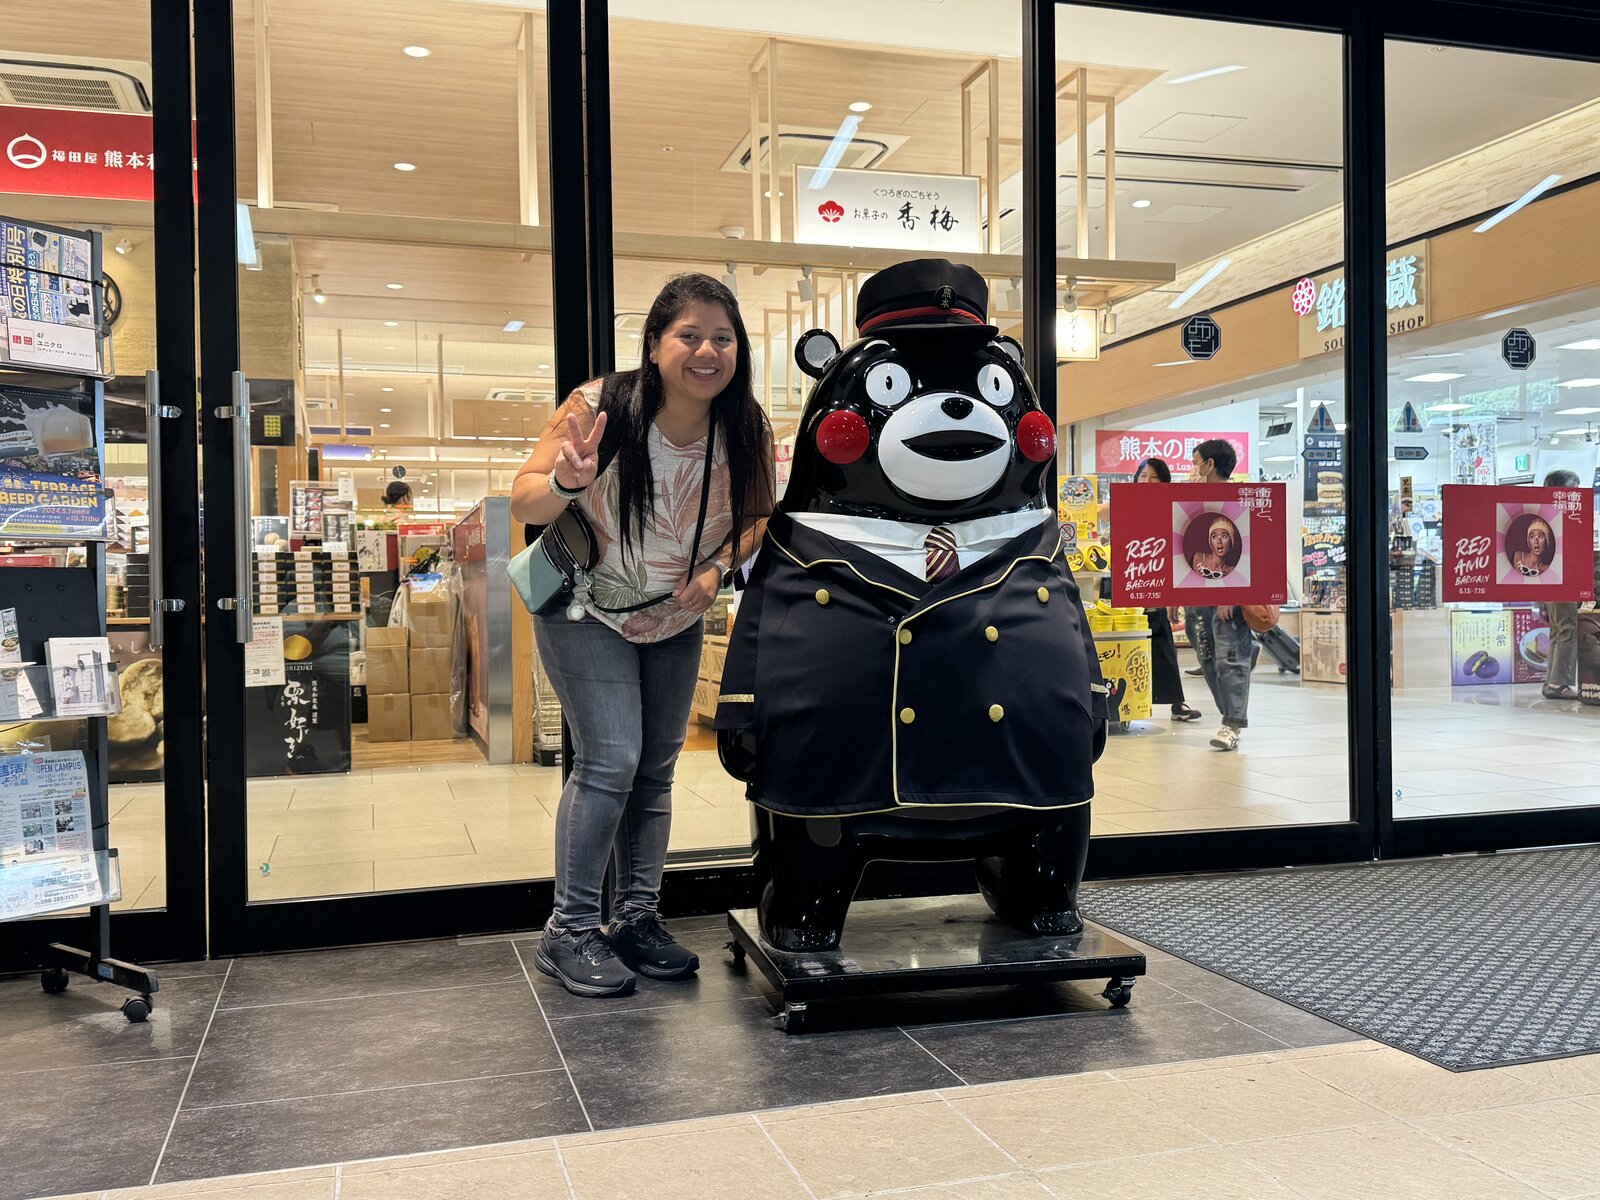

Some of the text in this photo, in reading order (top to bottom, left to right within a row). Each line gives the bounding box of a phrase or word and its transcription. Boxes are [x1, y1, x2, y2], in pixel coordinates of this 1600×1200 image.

[51, 149, 97, 164] 福田屋
[872, 188, 940, 200] くつろぎのごちそう
[853, 201, 959, 232] お菓子の 香梅
[940, 285, 952, 309] 熊本
[1389, 315, 1425, 334] SHOP
[37, 340, 62, 349] ユニクロ
[30, 480, 96, 495] TERRACE
[0, 491, 98, 508] BEER GARDEN
[1125, 536, 1166, 562] RED
[1455, 535, 1491, 559] RED
[1123, 557, 1165, 581] AMU
[1453, 555, 1490, 576] AMU
[1124, 577, 1166, 591] BARGAIN
[1454, 574, 1490, 586] BARGAIN
[36, 761, 82, 774] OPEN CAMPUS
